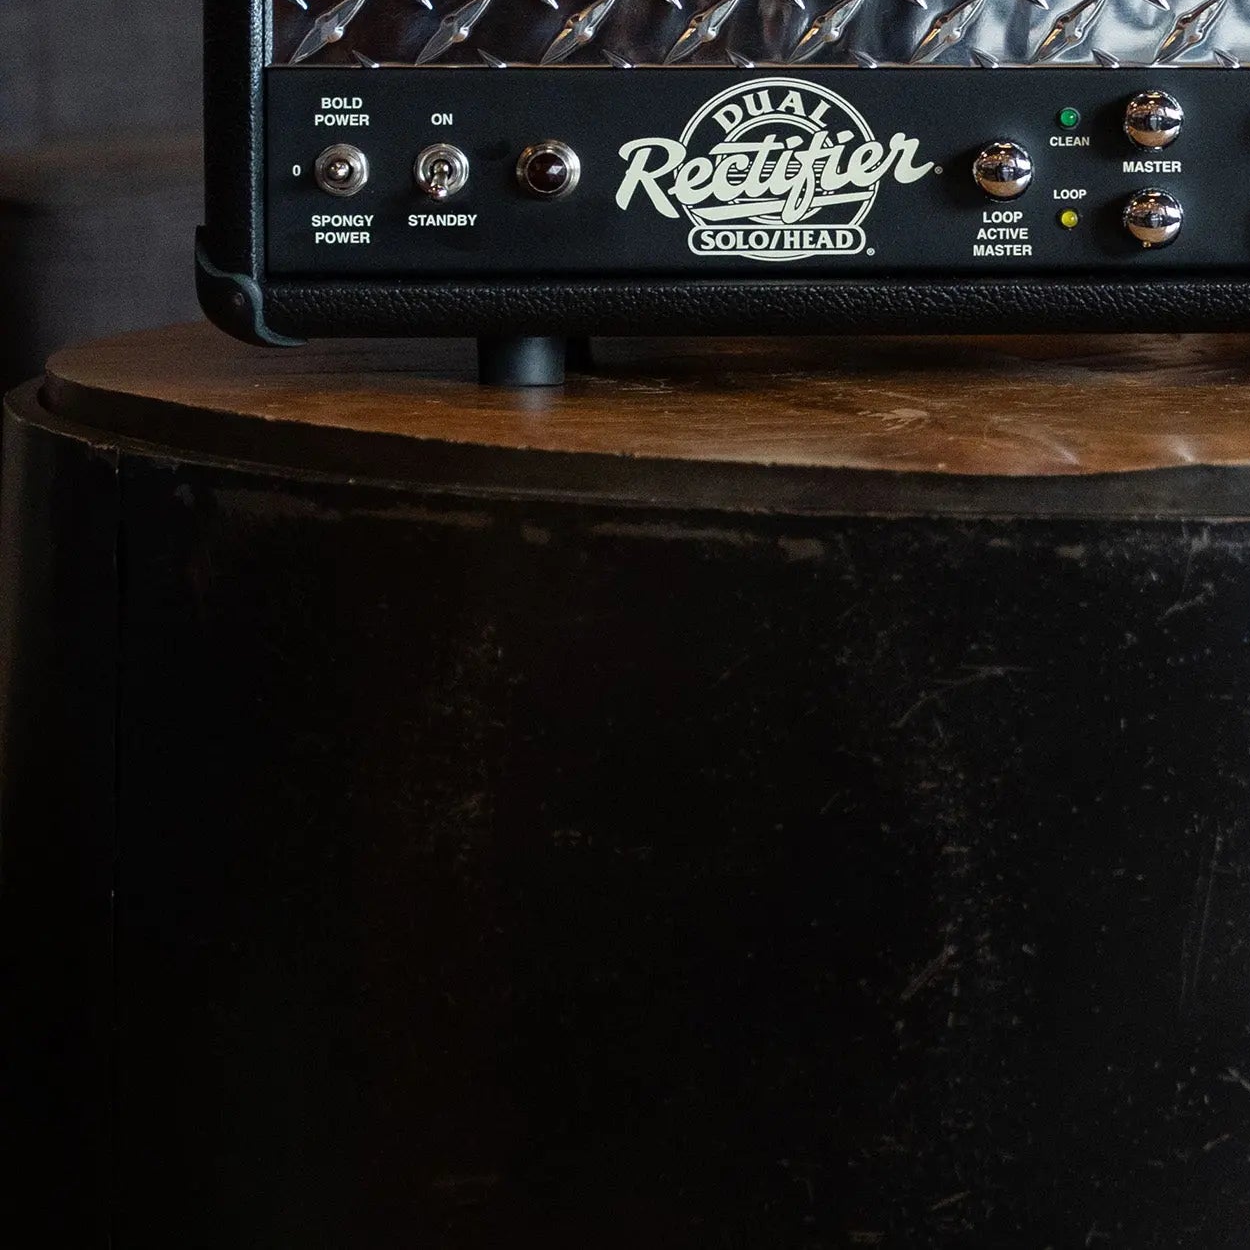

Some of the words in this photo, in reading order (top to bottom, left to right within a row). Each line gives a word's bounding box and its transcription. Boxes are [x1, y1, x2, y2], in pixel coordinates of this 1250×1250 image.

[321, 96, 363, 110] BOLD
[712, 90, 831, 133] DUAL
[314, 113, 370, 127] POWER
[430, 112, 453, 126] ON
[1049, 135, 1090, 147] CLEAN
[1122, 160, 1182, 174] MASTER
[615, 130, 935, 225] Rectifier
[1053, 188, 1087, 200] LOOP
[311, 214, 374, 228] SPONGY
[408, 214, 478, 227] STANDBY
[982, 210, 1024, 224] LOOP
[315, 231, 371, 244] POWER
[700, 228, 854, 251] SOLO/HEAD
[976, 227, 1029, 240] ACTIVE
[972, 244, 1033, 257] MASTER
